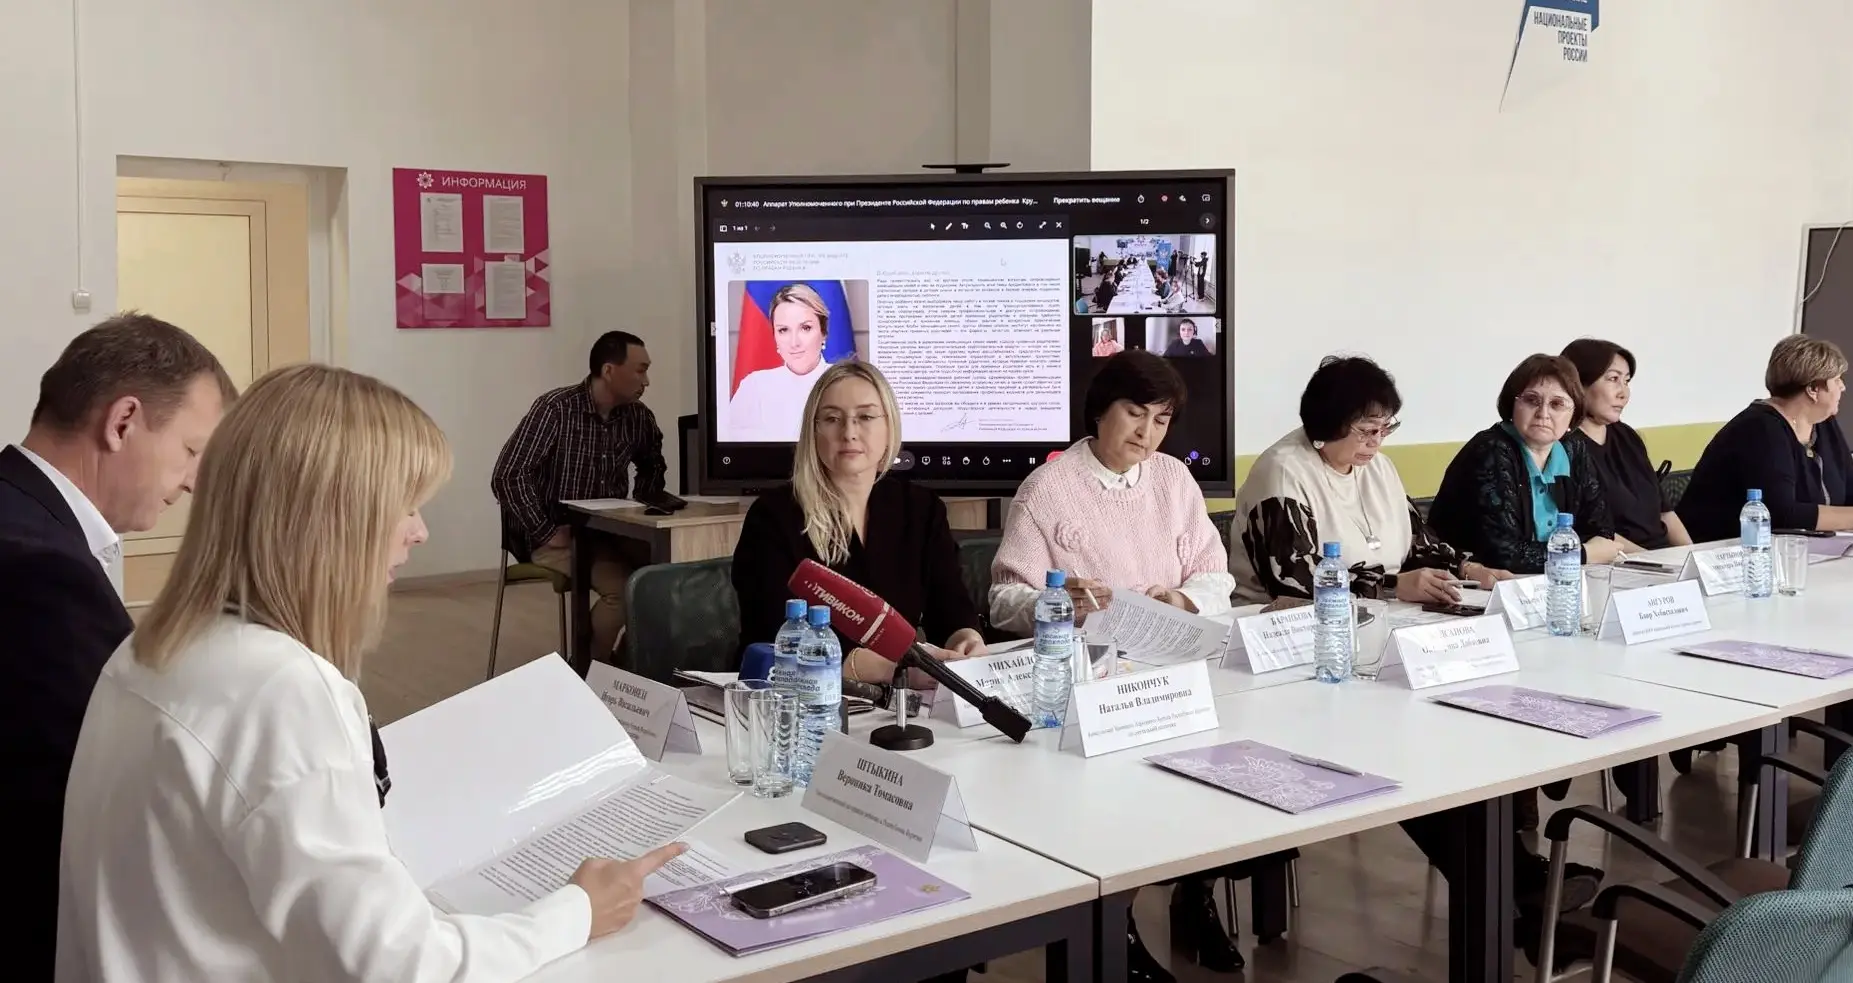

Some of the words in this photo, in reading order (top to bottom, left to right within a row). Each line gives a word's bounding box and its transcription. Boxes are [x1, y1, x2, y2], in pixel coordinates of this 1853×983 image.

[1534, 11, 1588, 31] НАЦИОНАЛЬНЫЕ
[1557, 30, 1588, 47] ПРОЕКТЫ
[1563, 46, 1588, 62] РОССИИ
[442, 176, 527, 191] ИНФОРМАЦИЯ
[763, 200, 787, 209] Аппарат
[789, 200, 843, 208] Уполномоченного
[844, 200, 855, 208] при
[856, 199, 891, 208] Президенте
[892, 198, 926, 206] Российской
[928, 198, 961, 207] Федерации
[995, 197, 1020, 206] ребенка
[1053, 196, 1090, 205] Прекратить
[1092, 196, 1121, 204] вещание
[814, 584, 865, 625] ТИВИКОМ
[1116, 675, 1170, 695] НИКОНЧУК
[618, 697, 650, 718] Васильевич
[1099, 701, 1134, 715] Наталья
[1135, 689, 1192, 707] Владимировна
[856, 757, 904, 787] ШТЫКИНА
[837, 769, 873, 794] Вероника
[873, 784, 914, 811] Томасовна
